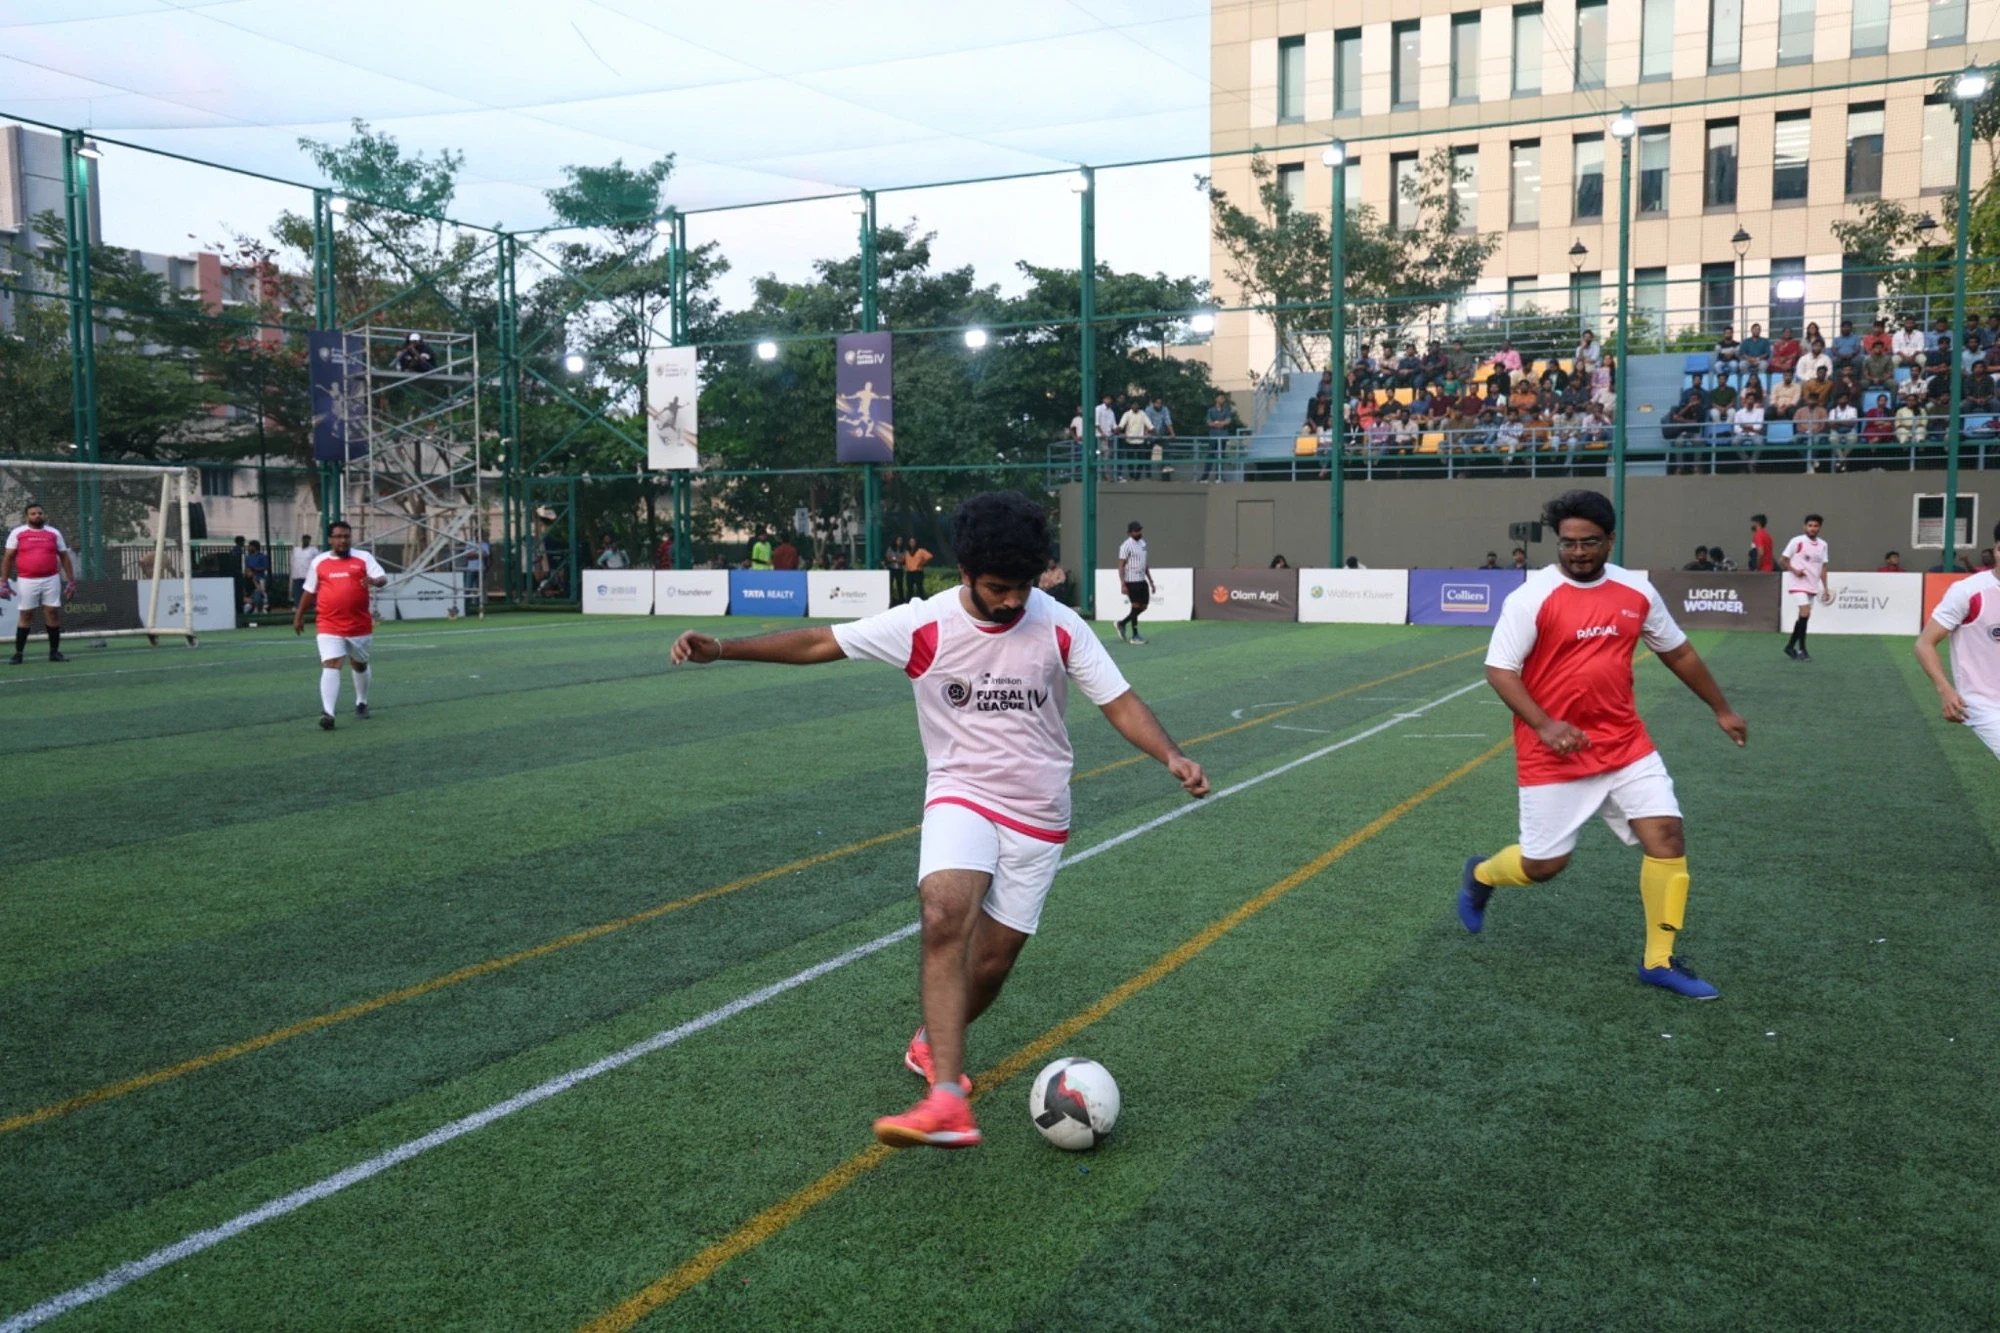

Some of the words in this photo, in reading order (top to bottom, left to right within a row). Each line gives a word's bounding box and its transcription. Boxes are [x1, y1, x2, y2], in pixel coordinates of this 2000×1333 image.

[677, 588, 712, 596] foundever
[742, 589, 765, 598] TATA
[767, 590, 794, 599] REALTY
[1230, 590, 1257, 600] Olam
[1259, 590, 1279, 602] Agri
[1327, 588, 1361, 599] Wolters
[1363, 590, 1394, 600] Kluwer
[1447, 589, 1484, 601] Colliers
[1688, 589, 1727, 600] LIGHT
[1728, 589, 1738, 600] &
[1684, 600, 1744, 614] WONDER
[1872, 596, 1889, 610] IV
[977, 690, 1024, 700] FUTSAL
[1027, 689, 1048, 711] IV
[977, 701, 1025, 711] LEAGUE
